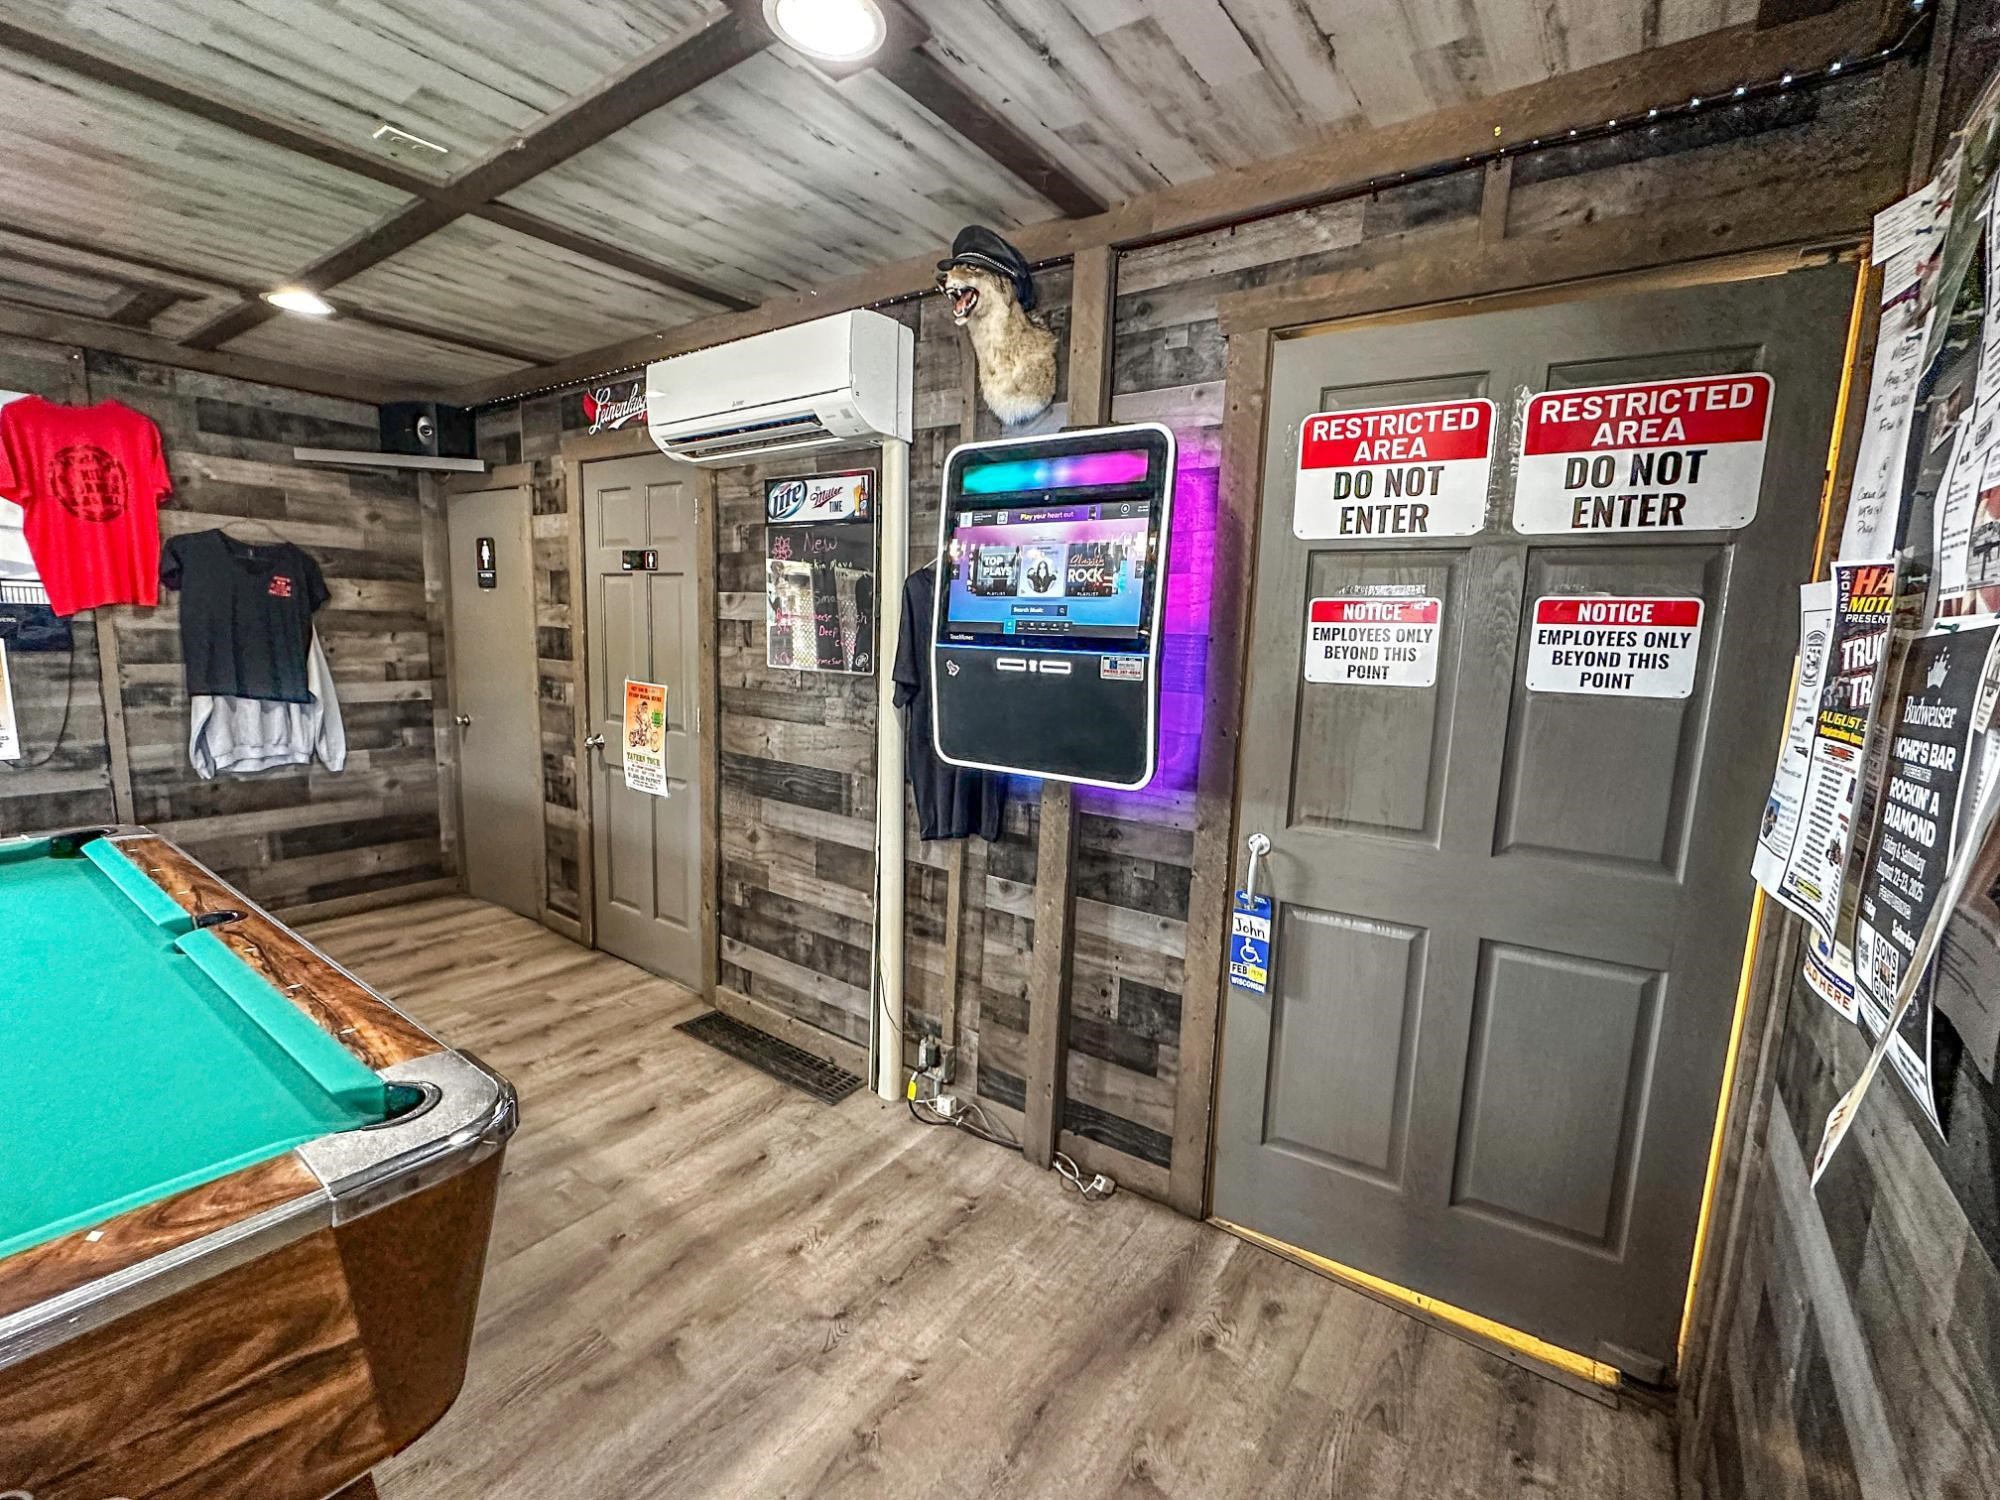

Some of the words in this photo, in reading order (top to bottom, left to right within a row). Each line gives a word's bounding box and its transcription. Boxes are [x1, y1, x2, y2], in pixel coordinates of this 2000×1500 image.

[588, 383, 648, 436] Leinenkug
[1540, 383, 1755, 424] RESTRICTED
[1312, 406, 1480, 442] RESTRICTED
[1590, 417, 1686, 447] AREA
[1353, 438, 1428, 462] AREA
[1564, 454, 1616, 490] DO
[1629, 449, 1708, 486] NOT
[1334, 471, 1372, 500] DO
[1384, 466, 1445, 497] NOT
[809, 486, 844, 509] Miller
[829, 500, 843, 513] TIME
[1020, 512, 1033, 521] Play
[1034, 513, 1046, 521] your
[1047, 510, 1063, 519] heart
[1340, 503, 1430, 535] ENTER
[1571, 493, 1687, 529] ENTER
[802, 531, 838, 553] New
[982, 566, 1013, 577] PLAYS
[983, 556, 1004, 567] TOP
[1067, 568, 1105, 582] ROCK
[1840, 570, 1851, 613] 2025
[1343, 603, 1403, 621] NOTICE
[1577, 602, 1653, 623] NOTICE
[1312, 627, 1392, 644] EMPLOYEES
[1395, 627, 1433, 644] ONLY
[1537, 629, 1638, 649] EMPLOYEES
[1643, 631, 1691, 649] ONLY
[1324, 645, 1380, 661] BEYOND
[1383, 646, 1417, 662] THIS
[1551, 650, 1621, 668] BEYOND
[1626, 651, 1670, 670] THIS
[1346, 664, 1390, 680] POINT
[1579, 670, 1634, 690] POINT
[1818, 710, 1862, 730] AUGUST
[1903, 696, 1957, 729] Budweiser
[1929, 743, 1956, 771] BAR
[1889, 777, 1931, 811] ROCKIN'
[1929, 792, 1940, 817] A
[1883, 805, 1937, 848] DIAMOND
[1882, 834, 1898, 861] Friday
[1901, 844, 1926, 879] Saturday
[1876, 857, 1895, 882] August
[1908, 877, 1925, 902] 2025
[1235, 917, 1265, 939] John
[1891, 918, 1916, 956] Saturday
[1876, 937, 1897, 969] SONS
[1232, 963, 1248, 975] FEB
[1231, 977, 1265, 993] WISCONSIN
[1819, 978, 1851, 1012] HERE
[1873, 979, 1895, 1010] GUNS
